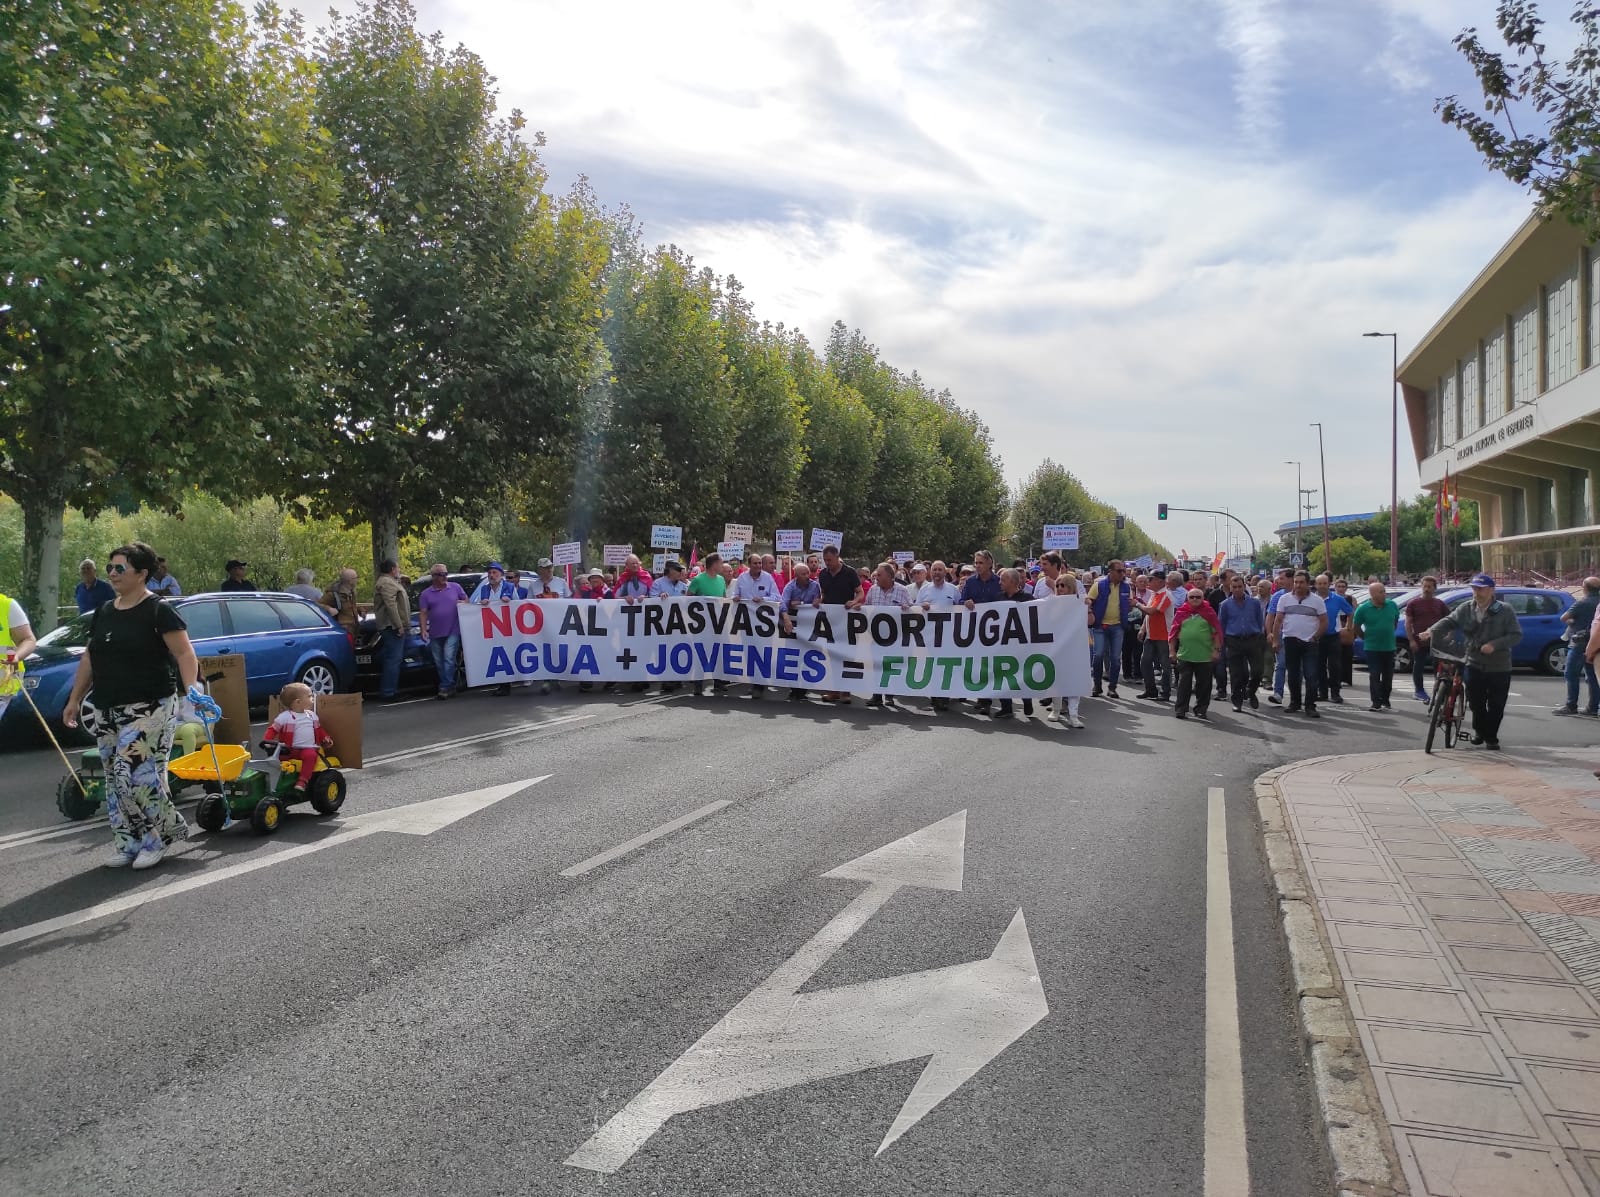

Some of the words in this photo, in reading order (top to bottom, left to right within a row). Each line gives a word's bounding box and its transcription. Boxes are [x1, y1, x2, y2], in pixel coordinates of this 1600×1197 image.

[481, 602, 544, 639] NO
[559, 604, 608, 637] AL
[620, 601, 799, 639] TRASVASE
[808, 611, 835, 643] A
[847, 605, 1054, 648] PORTUGAL
[485, 642, 601, 678] AGUA
[616, 648, 638, 670] +
[645, 642, 827, 683] JOVENES
[841, 660, 865, 679] =
[879, 653, 1056, 692] FUTURO
